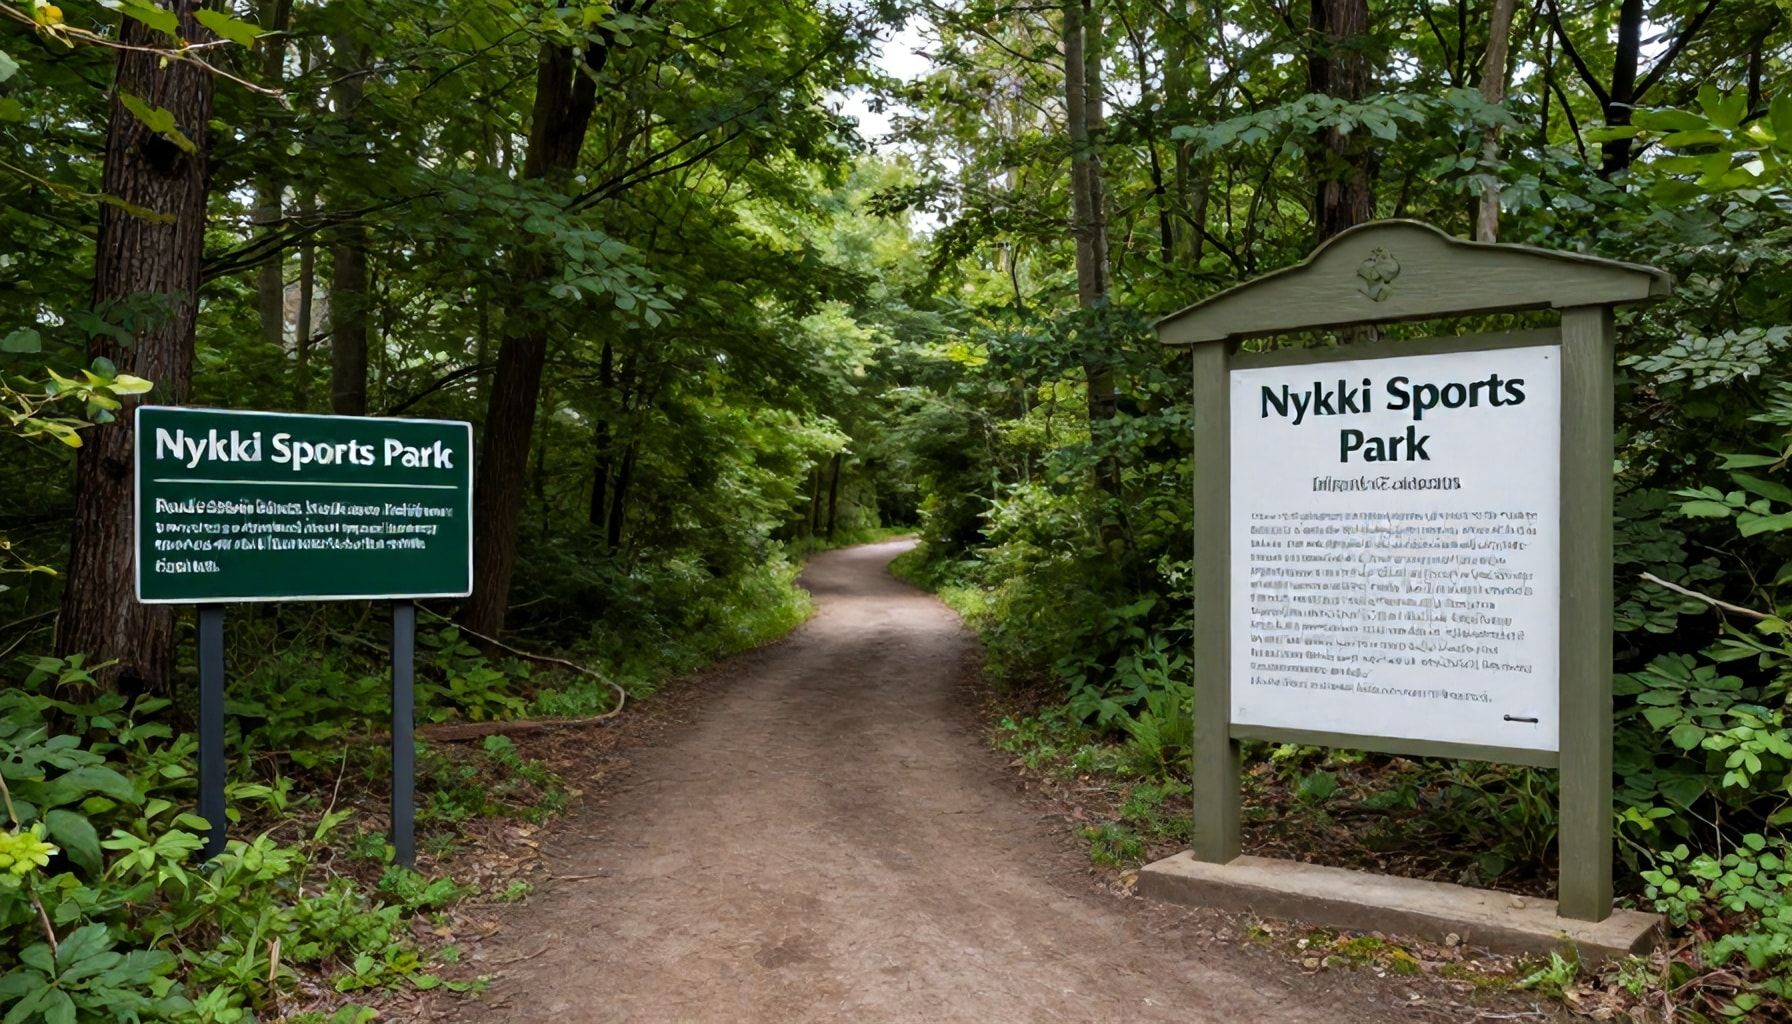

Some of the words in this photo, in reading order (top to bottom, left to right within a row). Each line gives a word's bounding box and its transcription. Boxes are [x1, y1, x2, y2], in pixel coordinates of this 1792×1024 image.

[1261, 378, 1372, 425] Nykki
[1386, 374, 1526, 420] Sports
[155, 428, 262, 469] Nykki
[270, 432, 376, 471] Sports
[384, 438, 454, 469] Park
[1340, 425, 1431, 463] Park
